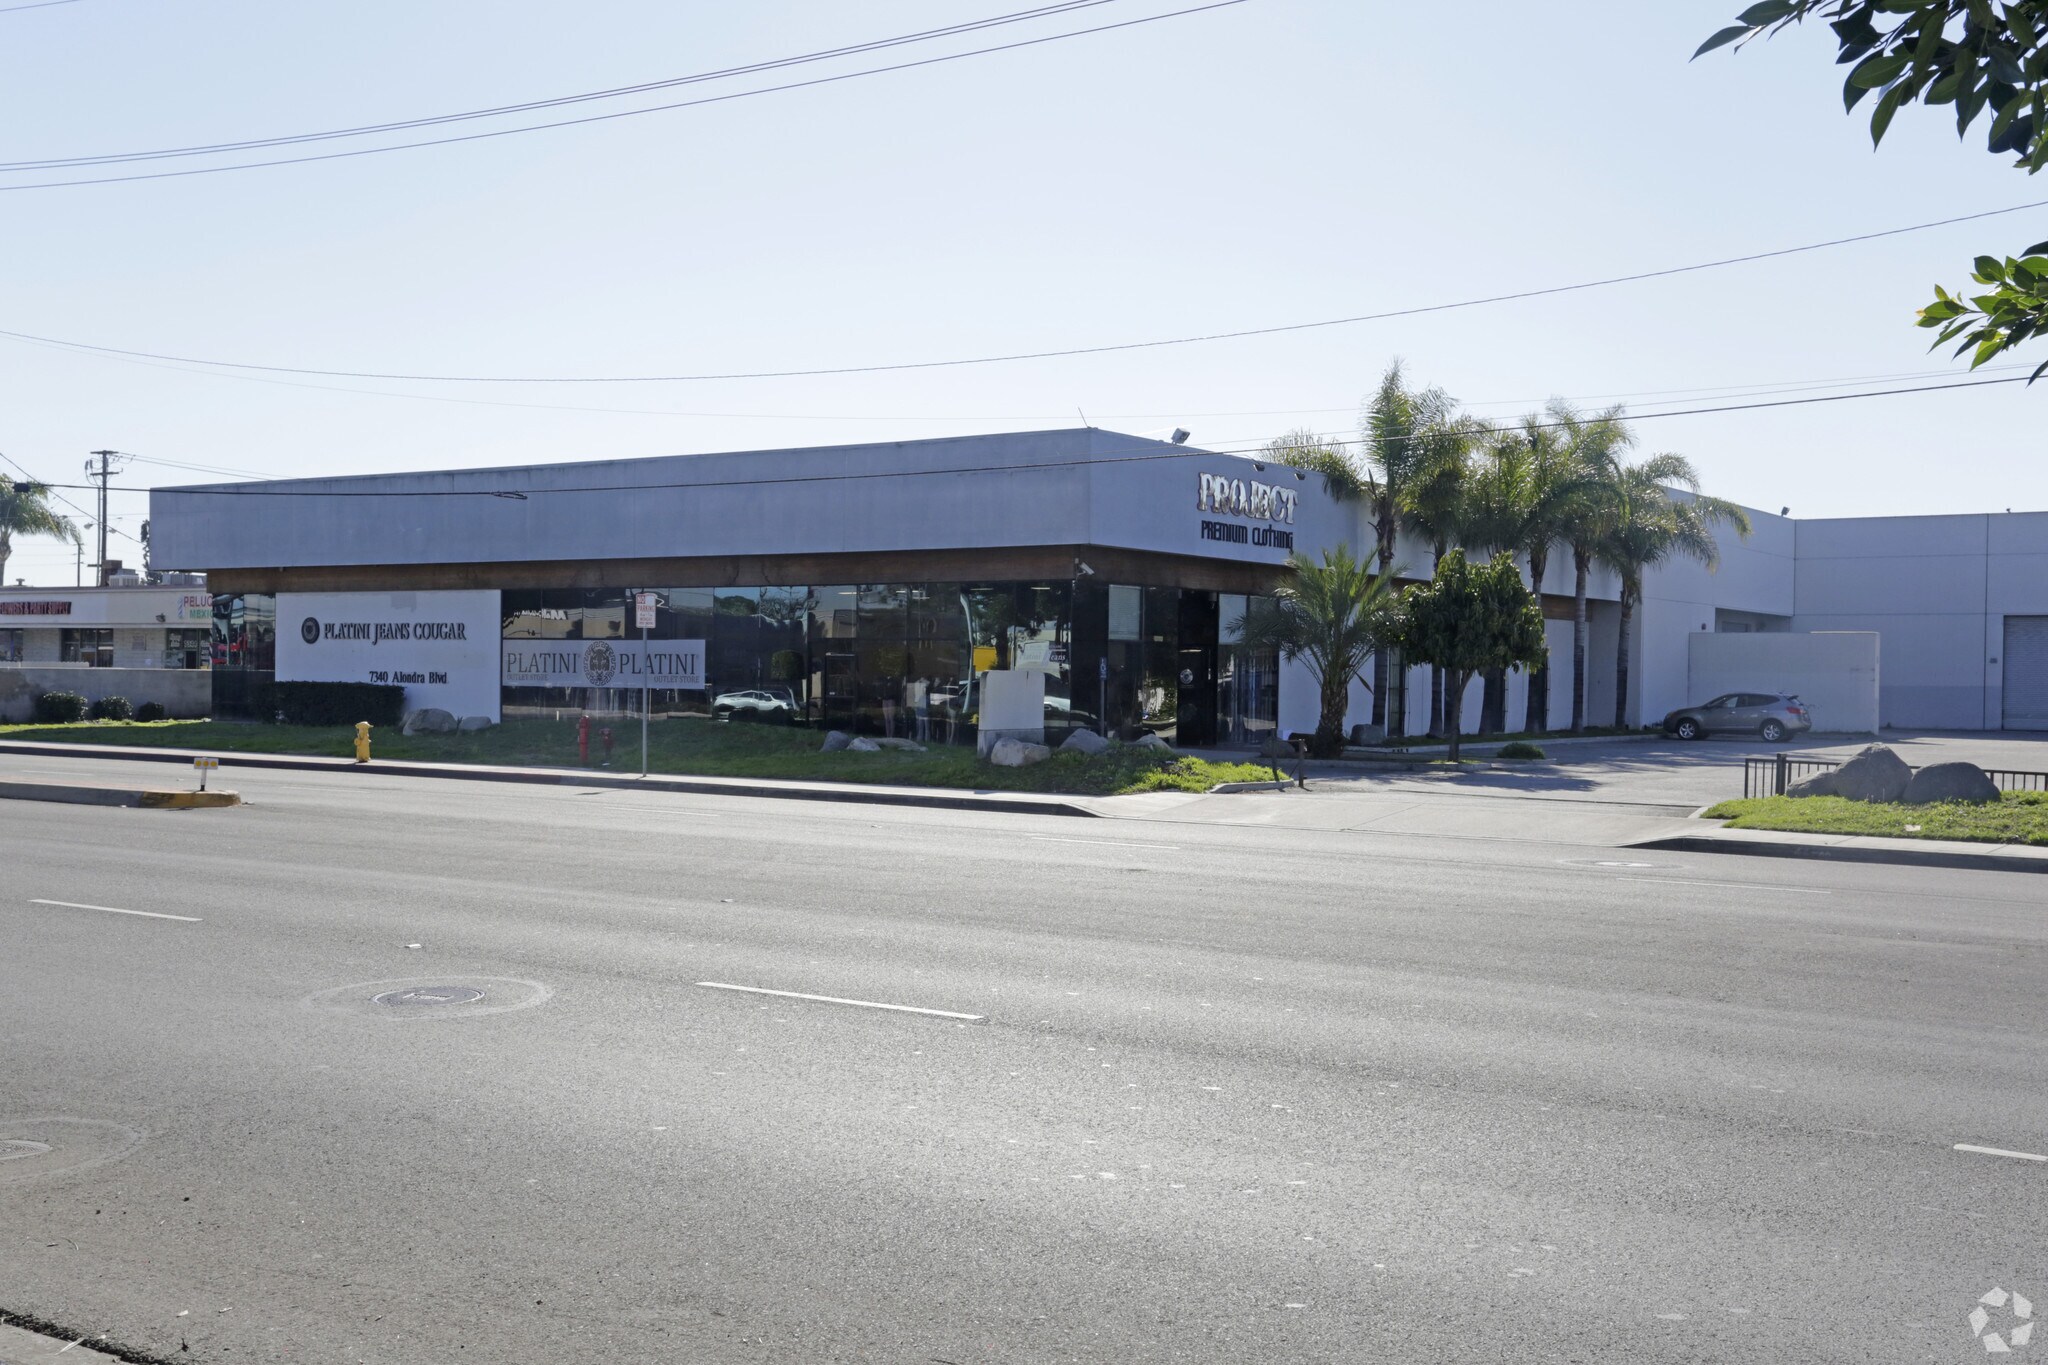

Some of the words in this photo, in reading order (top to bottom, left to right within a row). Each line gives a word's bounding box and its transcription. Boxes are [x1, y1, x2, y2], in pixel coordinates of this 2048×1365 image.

[1197, 472, 1298, 524] PROJECT
[1201, 520, 1248, 544] PREMIUM
[1252, 524, 1294, 555] CLOTHING
[323, 623, 370, 640] PLATINI
[371, 623, 409, 645] JEANS
[412, 622, 467, 640] COUGAR
[506, 652, 577, 674] PLATINI
[619, 653, 697, 675] PLATINI
[368, 671, 388, 682] 7340
[392, 671, 425, 684] Alondra
[428, 671, 447, 684] Blvd
[506, 673, 529, 681] OUTLET
[530, 673, 549, 681] STORE
[654, 675, 678, 683] OUTLET
[679, 675, 700, 683] STORE
